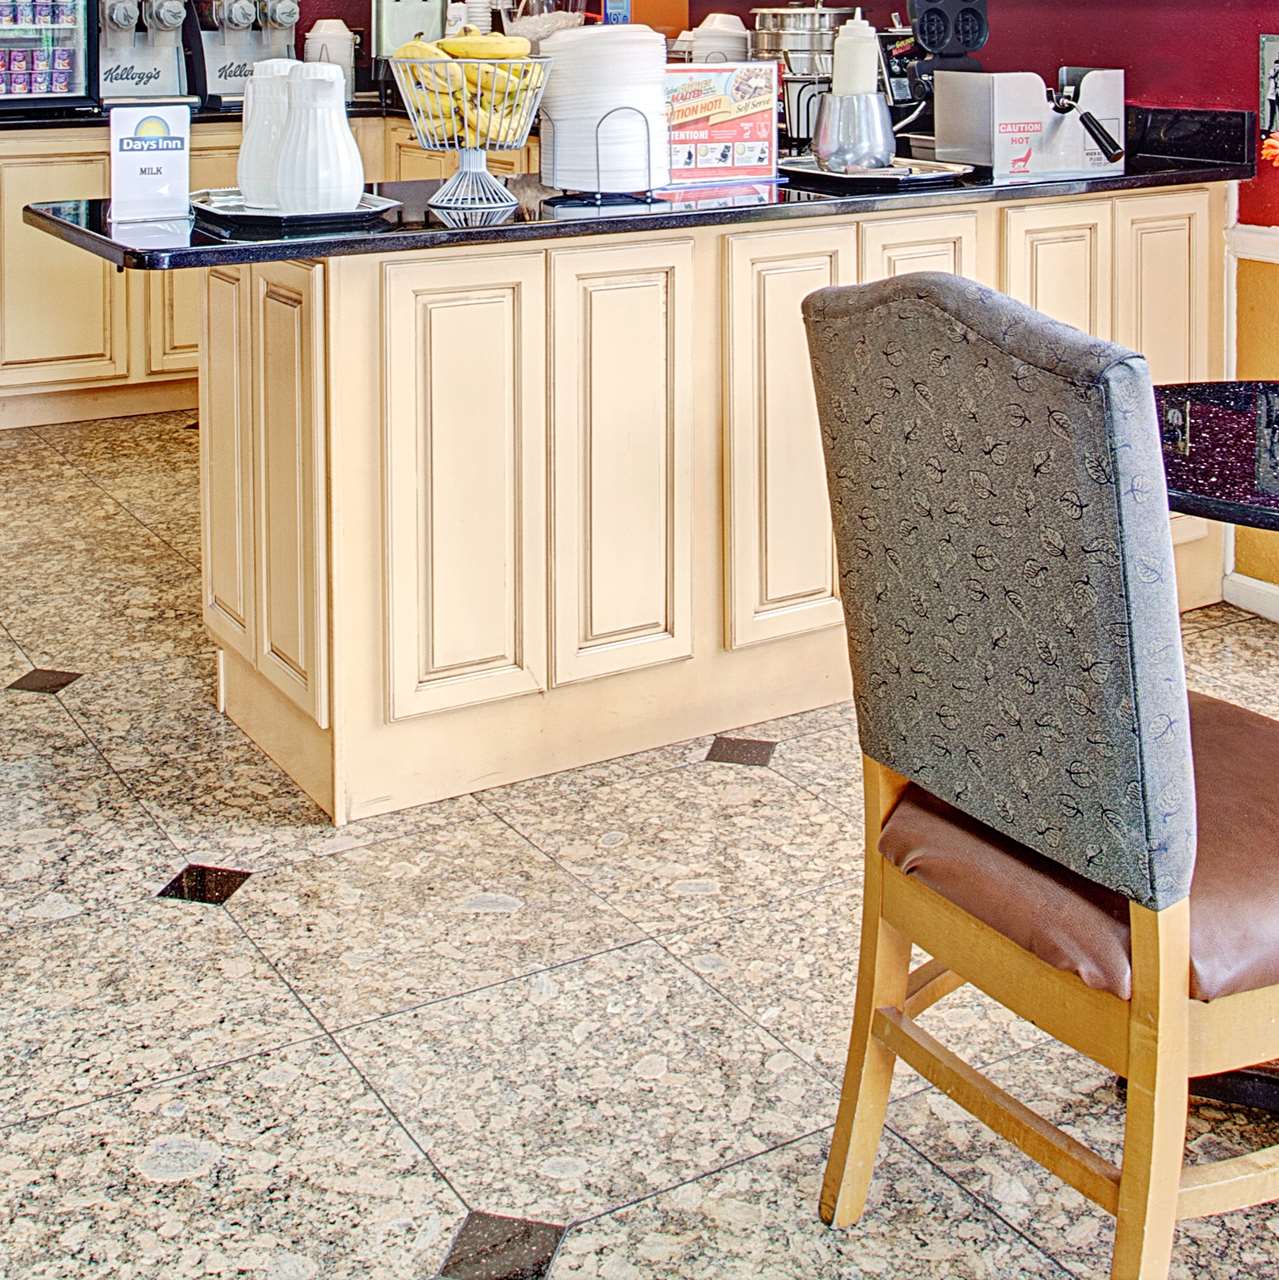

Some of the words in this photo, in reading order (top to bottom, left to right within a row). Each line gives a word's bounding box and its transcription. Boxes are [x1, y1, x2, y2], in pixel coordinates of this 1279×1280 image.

[104, 65, 161, 86] Kellogg's
[218, 62, 255, 81] Kello
[699, 99, 722, 113] HOT!
[736, 102, 751, 114] Self
[1000, 123, 1042, 133] CAUTION
[123, 138, 158, 152] Days
[158, 138, 182, 150] Inn
[1010, 136, 1030, 145] HOT
[139, 166, 163, 176] MILK
